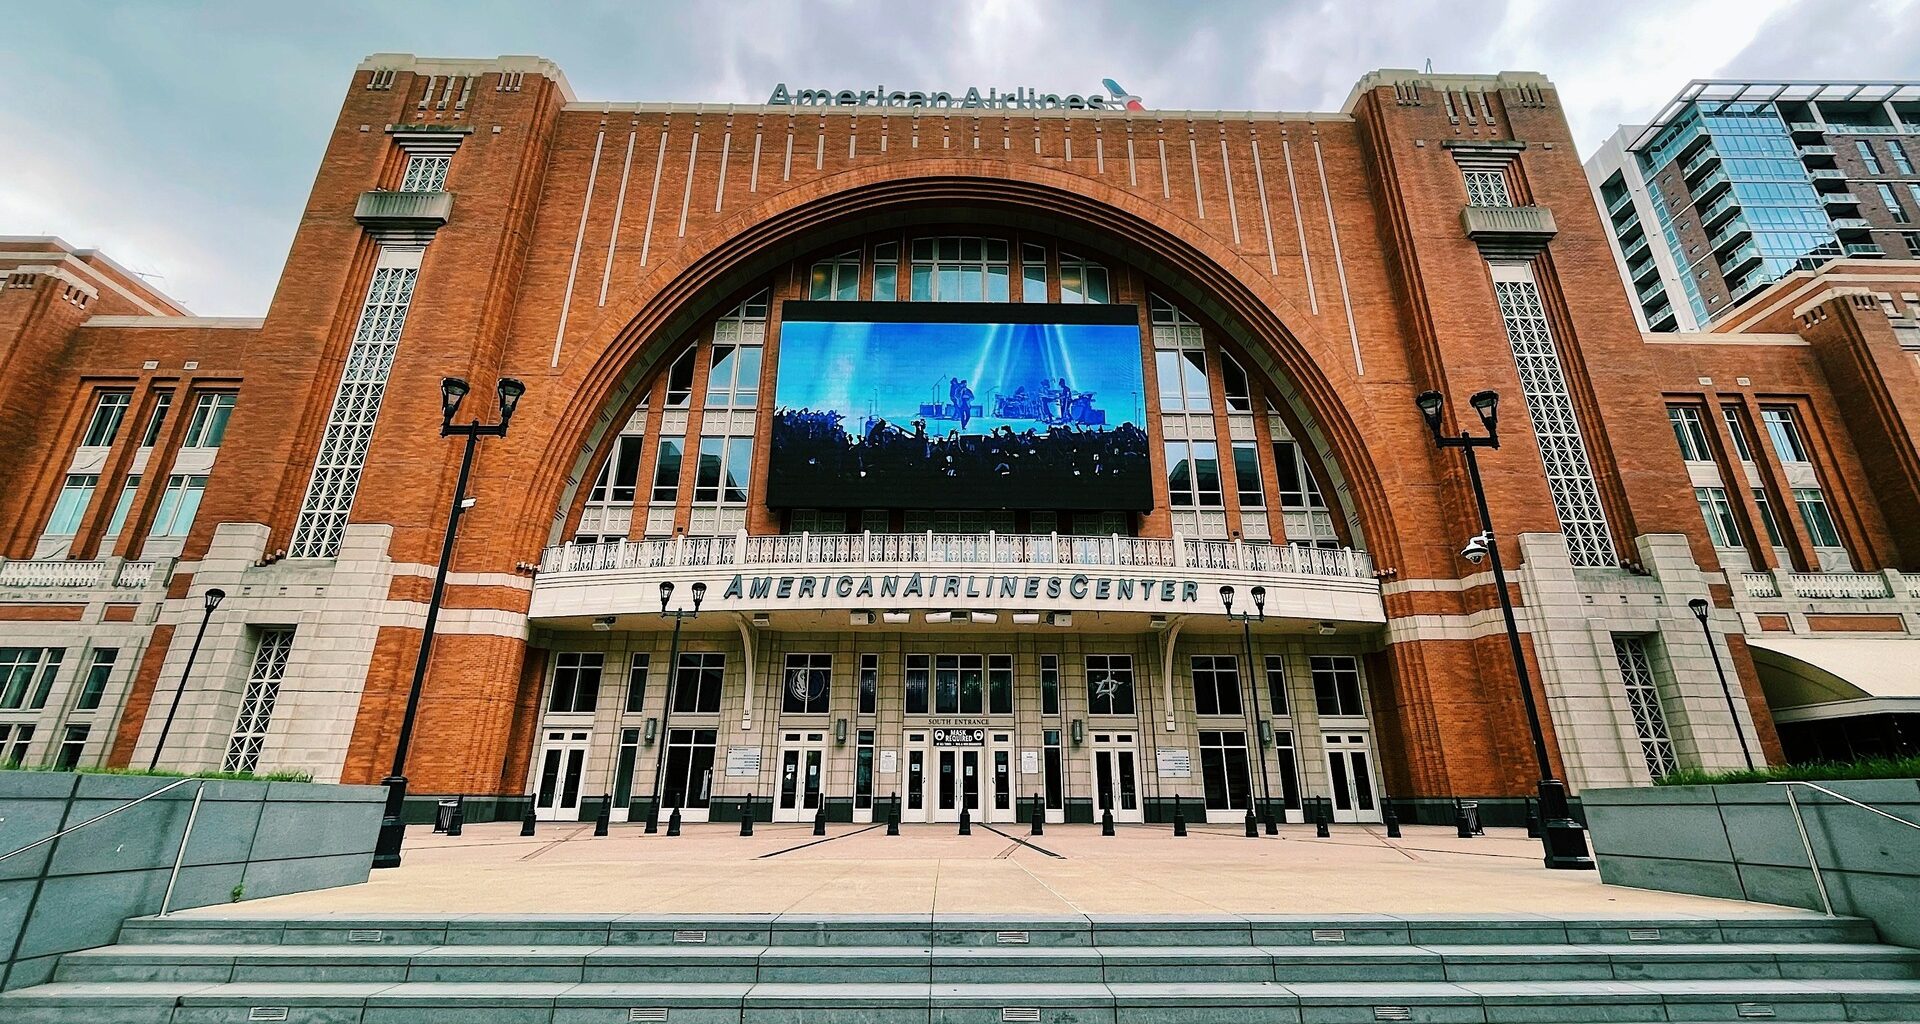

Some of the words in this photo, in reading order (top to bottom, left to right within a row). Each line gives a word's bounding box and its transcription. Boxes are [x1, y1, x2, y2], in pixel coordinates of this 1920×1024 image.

[767, 83, 953, 109] American
[959, 86, 1105, 111] Airlines
[724, 573, 900, 599] AMERICAN
[902, 572, 1062, 599] AIRLINES
[1069, 573, 1199, 602] CENTER
